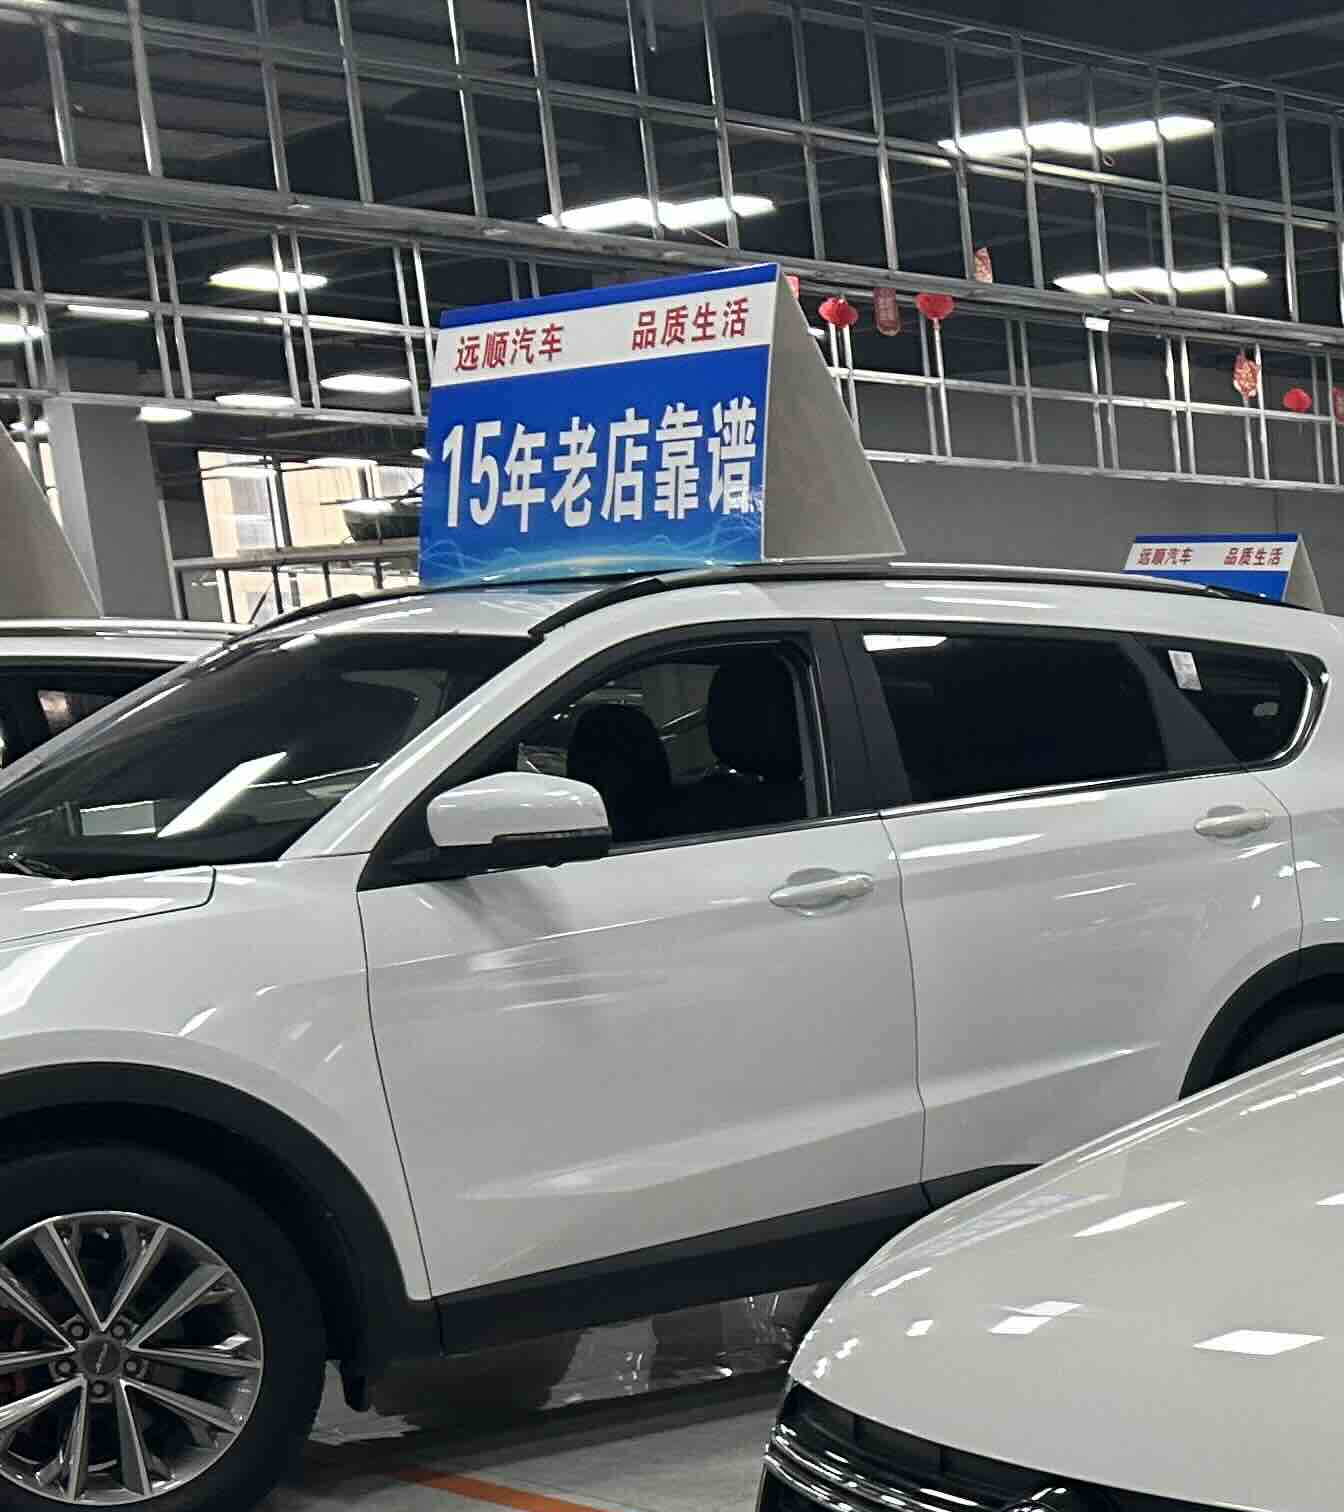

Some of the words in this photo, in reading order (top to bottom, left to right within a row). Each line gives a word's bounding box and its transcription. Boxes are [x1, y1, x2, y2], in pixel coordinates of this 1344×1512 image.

[455, 324, 564, 372] 远顺汽车
[632, 298, 749, 350] 品质生活
[442, 396, 757, 532] 15年老店靠谱
